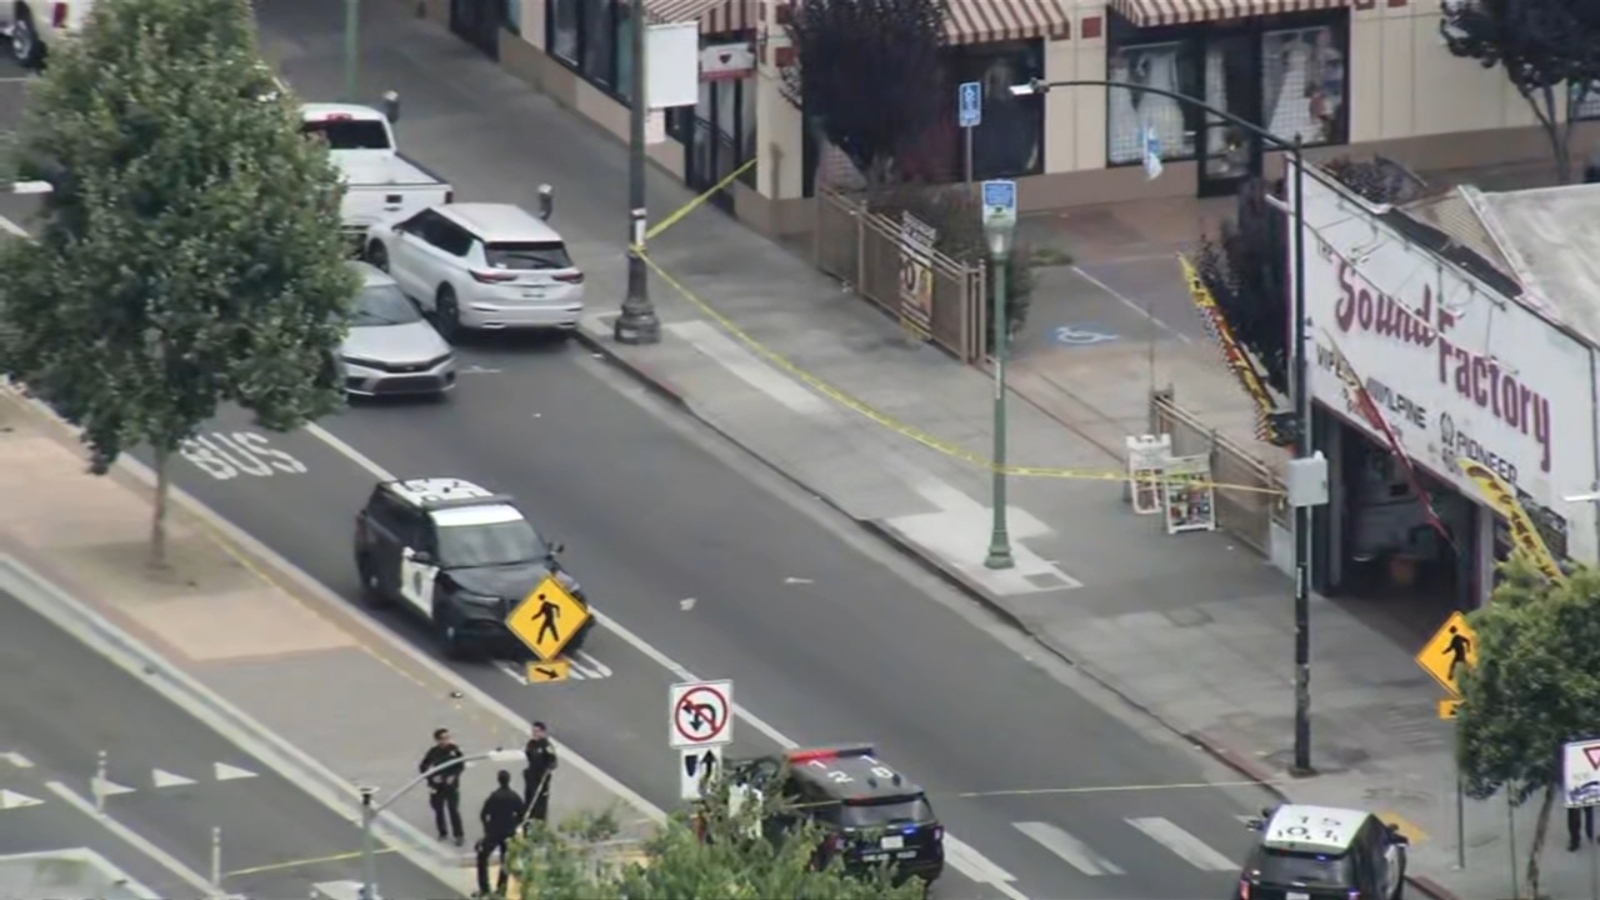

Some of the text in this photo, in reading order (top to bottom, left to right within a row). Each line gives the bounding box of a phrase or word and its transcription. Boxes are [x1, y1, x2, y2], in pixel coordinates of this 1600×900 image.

[1335, 258, 1551, 473] Sound Factory
[179, 430, 308, 480] BUS
[1455, 430, 1518, 484] PIONEER
